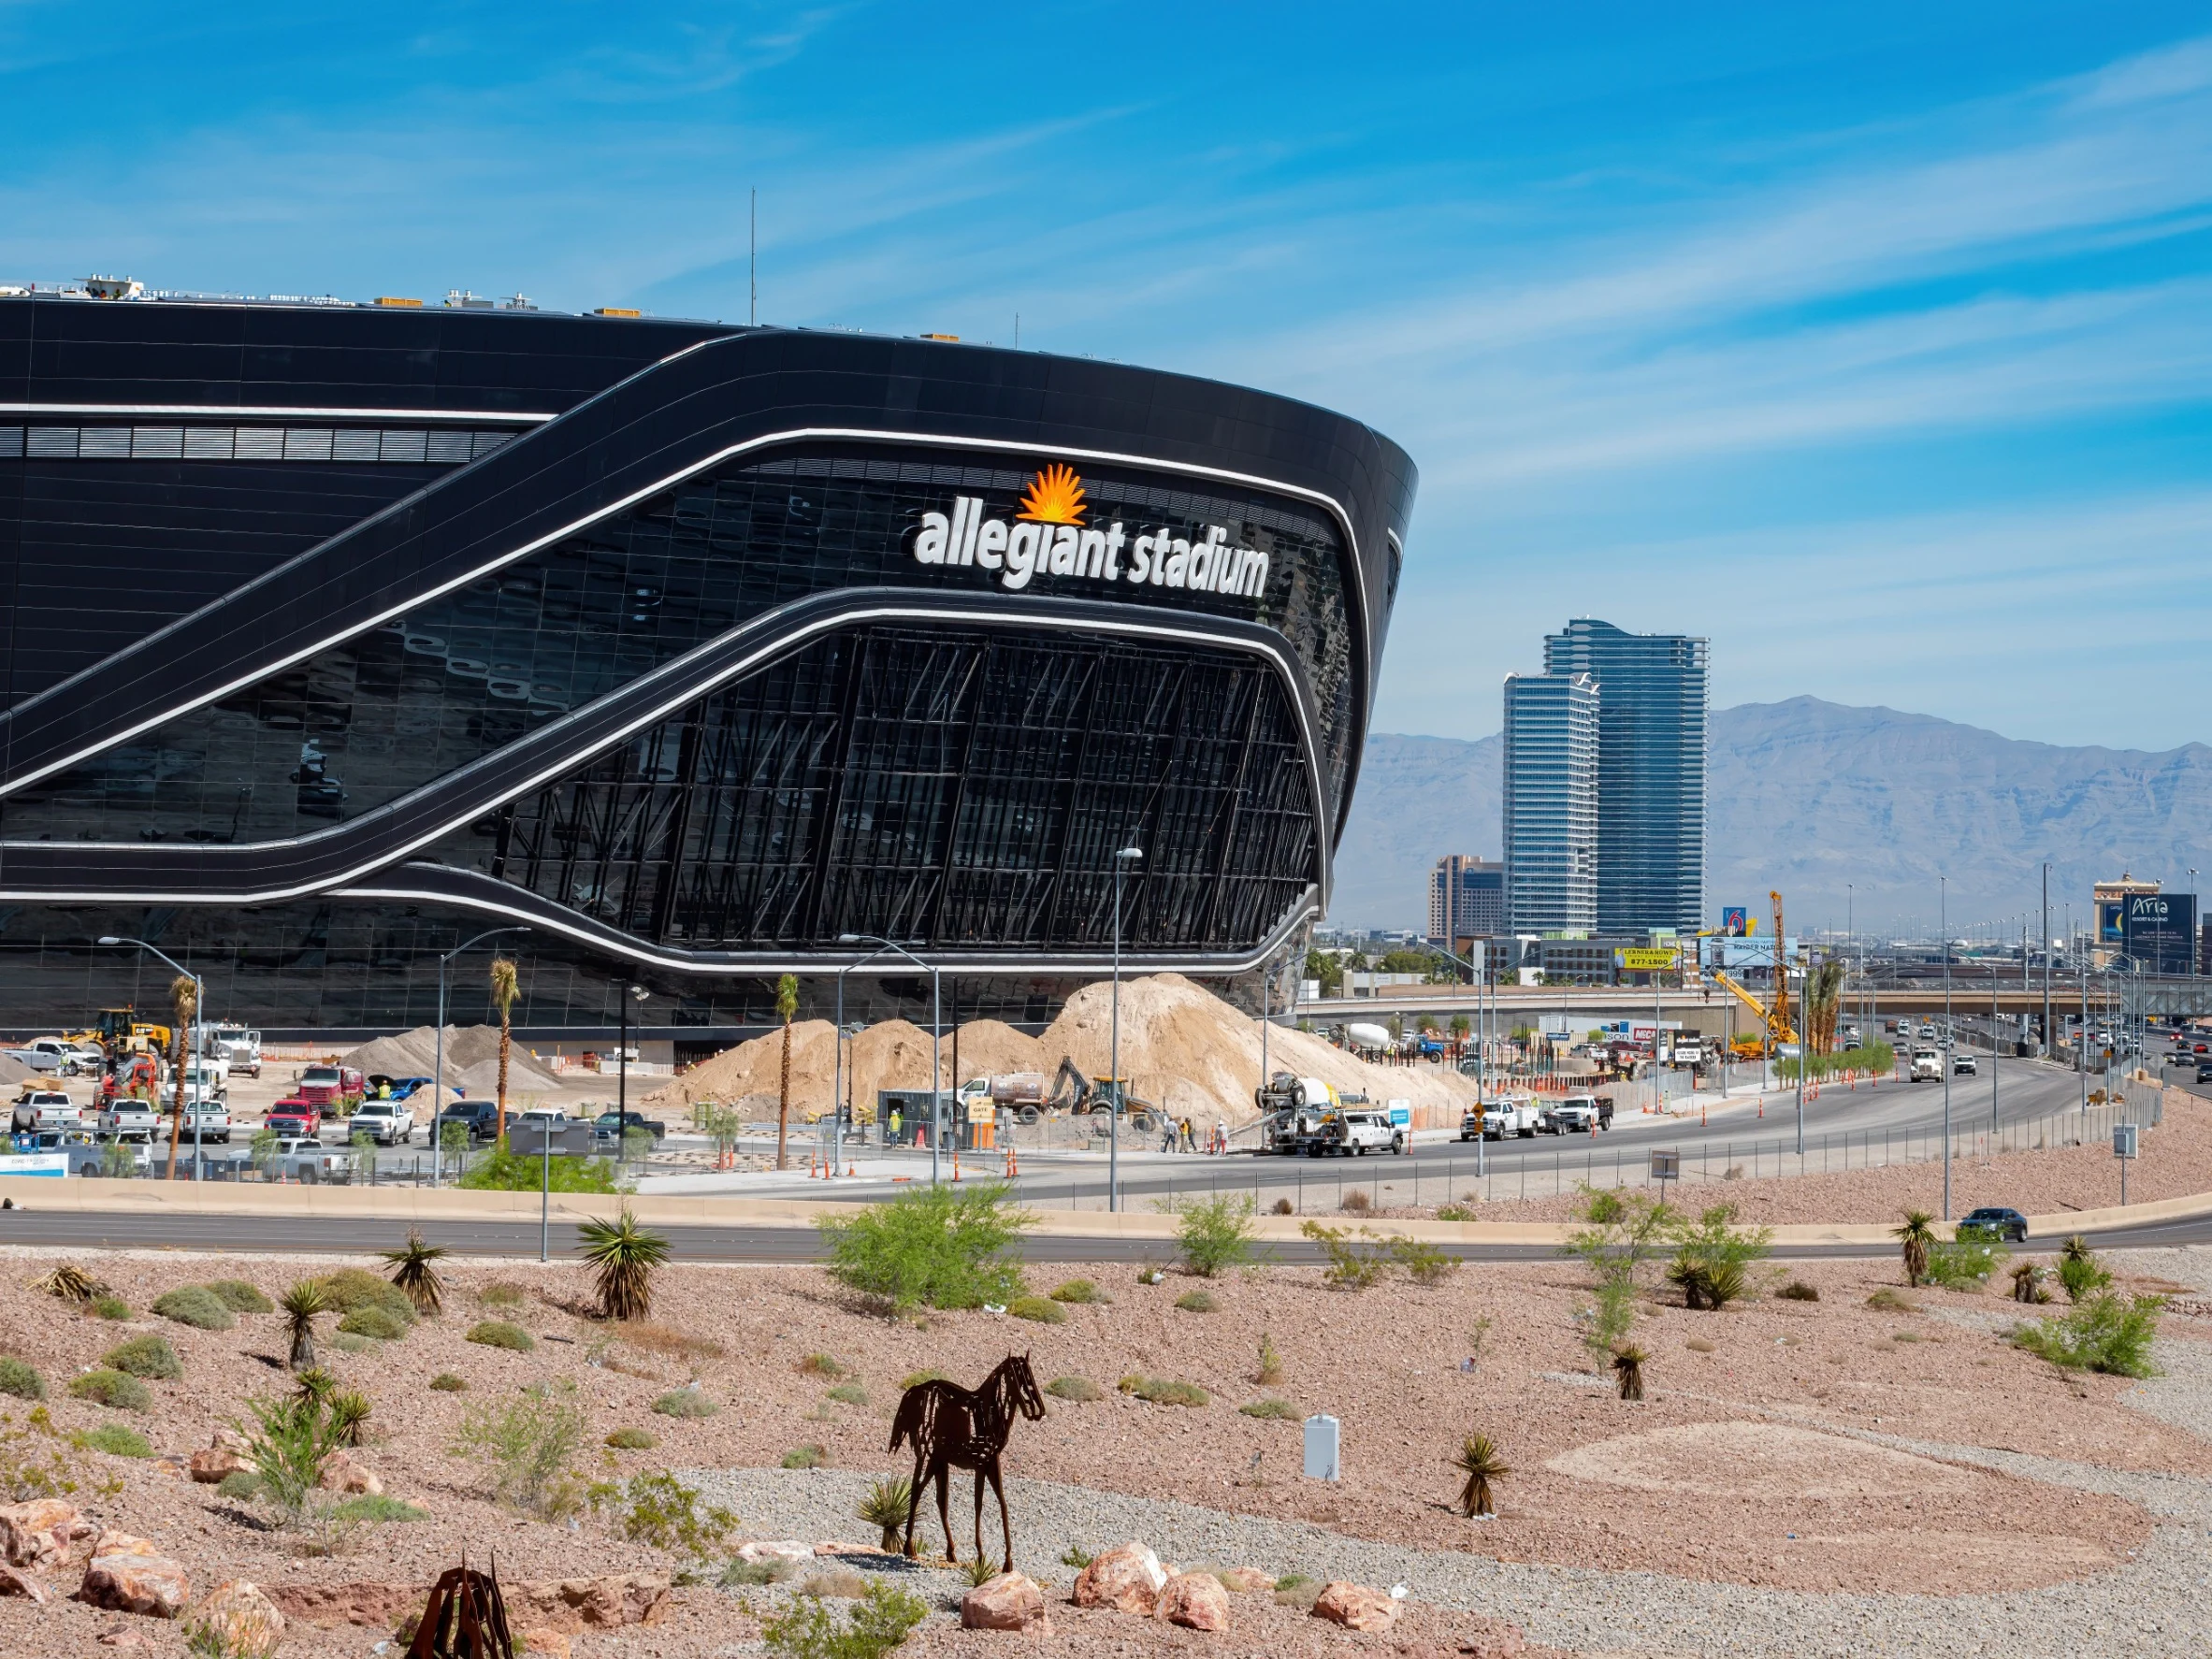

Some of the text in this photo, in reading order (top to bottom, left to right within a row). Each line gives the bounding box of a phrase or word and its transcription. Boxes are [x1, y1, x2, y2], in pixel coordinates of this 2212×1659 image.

[914, 496, 1270, 598] allegiant stadium
[2132, 897, 2168, 916] Aria
[1728, 909, 1744, 931] 6
